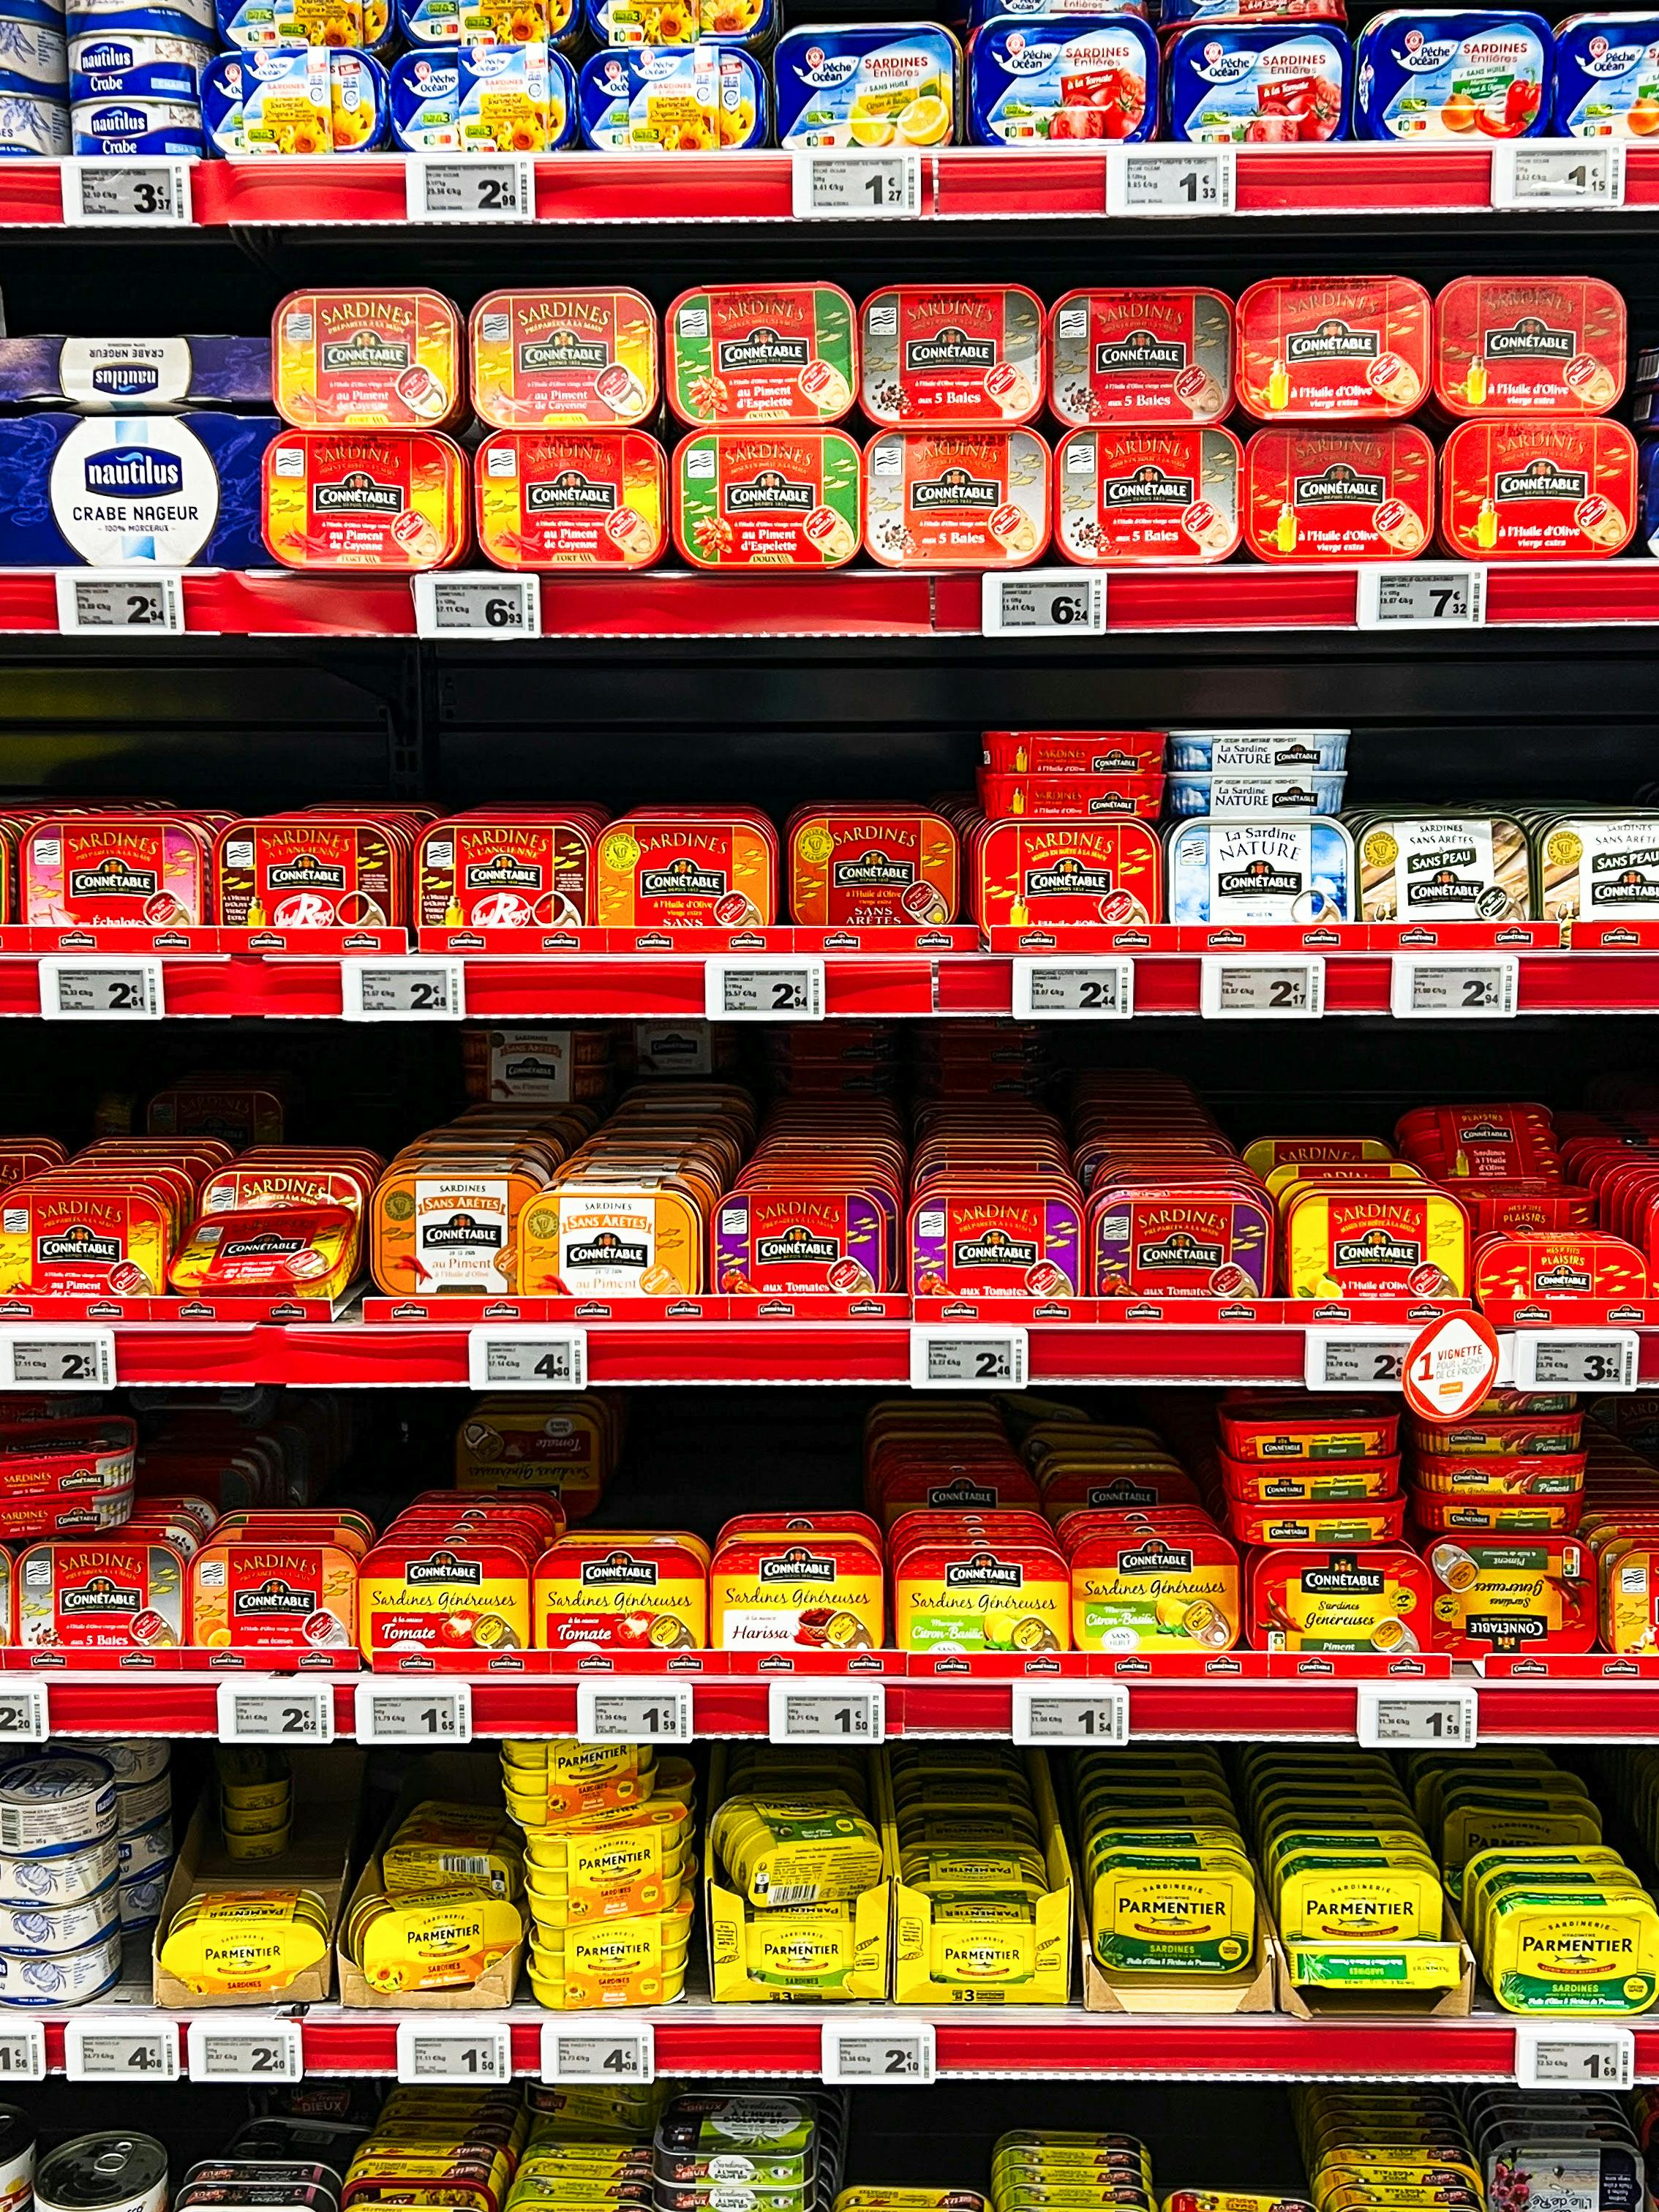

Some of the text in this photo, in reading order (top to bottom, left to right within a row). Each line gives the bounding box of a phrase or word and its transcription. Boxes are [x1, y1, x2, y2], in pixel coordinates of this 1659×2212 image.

[1023, 49, 1052, 60] Pêche
[1065, 47, 1129, 58] SARDINES
[1421, 46, 1449, 57] Pêche
[1464, 43, 1527, 54] SARDINES
[82, 47, 130, 69] nautilus
[865, 56, 928, 69] SARDINES
[1012, 60, 1042, 68] Océan
[1410, 56, 1439, 64] Océan
[823, 62, 851, 73] Pêche
[91, 76, 122, 91] Crabe
[430, 74, 456, 86] Pêche
[813, 73, 842, 81] Océan
[1075, 80, 1083, 89] la
[1086, 73, 1113, 87] Tomate
[421, 83, 448, 91] Océan
[478, 180, 501, 208] 2
[502, 195, 516, 206] 99
[865, 176, 882, 204] 1
[889, 190, 901, 200] 27
[1179, 173, 1196, 201] 1
[1203, 189, 1216, 198] 33
[134, 184, 157, 212] 3
[158, 199, 170, 210] 37
[320, 302, 412, 326] SARDINES
[1292, 334, 1371, 351] CONNÉTABLE
[90, 350, 164, 358] CRABE NAGEUR
[328, 346, 404, 361] CONNÉTABLE
[912, 342, 988, 359] CONNÉTABLE
[96, 372, 156, 390] nautilus
[936, 394, 943, 404] 5
[947, 392, 981, 405] Baies
[1291, 385, 1372, 398] à l'Huile d'Olive
[89, 457, 178, 484] nautilus
[533, 486, 609, 504] CONNÉTABLE
[732, 487, 808, 503] CONNÉTABLE
[73, 506, 198, 521] CRABE NAGEUR
[560, 530, 597, 542] Piment
[758, 530, 796, 541] Piment
[544, 541, 597, 552] de Cayenne
[741, 540, 797, 552] d'Espelette
[127, 595, 150, 622] 2
[151, 612, 163, 621] 94
[1051, 596, 1074, 625] 6
[1075, 611, 1087, 620] 24
[1429, 590, 1453, 617] 7
[1453, 604, 1466, 614] 32
[486, 599, 508, 626] 6
[509, 614, 522, 623] 93
[1220, 745, 1268, 754] La Sardine
[1217, 753, 1271, 764] NATURE
[1226, 829, 1296, 841] La Sardine
[1420, 824, 1463, 833] SARDINES
[69, 832, 159, 854] SARDINES
[461, 830, 549, 852] SARDINES
[640, 833, 727, 854] SARDINES
[833, 826, 917, 847] SARDINES
[1410, 832, 1473, 846] SANS ARÊTES
[477, 847, 538, 859] L'ANCIENNE
[1219, 840, 1301, 862] NATURE
[1412, 851, 1470, 870] SANS PEAU
[471, 868, 535, 882] CONNÉTABLE
[839, 865, 908, 879] CONNÉTABLE
[76, 874, 150, 889] CONNÉTABLE
[646, 873, 719, 889] CONNÉTABLE
[1223, 874, 1296, 888] CONNÉTABLE
[1409, 883, 1478, 899] CONNÉTABLE
[854, 907, 892, 916] SANS
[846, 914, 901, 925] ARÊTES
[109, 982, 131, 1009] 2
[132, 997, 143, 1007] 61
[772, 983, 794, 1009] 2
[794, 997, 808, 1007] 94
[1270, 980, 1292, 1006] 2
[1293, 995, 1306, 1004] 17
[425, 1196, 500, 1208] SANS ARÊTES
[37, 1200, 123, 1223] SARDINES
[756, 1202, 840, 1222] SARDINES
[1334, 1204, 1422, 1226] SARDINES
[426, 1227, 496, 1241] CONNÉTABLE
[43, 1240, 114, 1256] CONNÉTABLE
[761, 1241, 833, 1256] CONNÉTABLE
[1339, 1246, 1414, 1261] CONNÉTABLE
[432, 1259, 491, 1268] au Piment
[1541, 1257, 1585, 1266] PLAISIRS
[763, 1282, 830, 1293] aux Tomates
[1538, 1274, 1587, 1286] CONNÉTABLE
[1437, 1345, 1483, 1361] VIGNETTE
[976, 1353, 998, 1377] 2
[997, 1366, 1009, 1375] 40
[1418, 1352, 1434, 1381] 1
[1437, 1360, 1455, 1369] POUR
[1445, 1369, 1455, 1377] CE
[1456, 1364, 1486, 1377] PRODUIT
[1584, 1355, 1605, 1380] 3
[1606, 1368, 1619, 1377] 92
[59, 1553, 142, 1573] SARDINES
[410, 1564, 476, 1579] CONNÉTABLE
[65, 1592, 135, 1606] CONNÉTABLE
[372, 1590, 516, 1610] Sardines Généreuses
[1319, 1601, 1359, 1611] Sardines
[382, 1624, 435, 1640] Tomate
[732, 1625, 790, 1639] Harissa
[911, 1625, 983, 1640] Citron-Basilic
[1323, 1642, 1355, 1651] Piment
[282, 1709, 303, 1732] 2
[304, 1721, 316, 1730] 62
[421, 1709, 437, 1732] 1
[442, 1722, 454, 1730] 65
[835, 1709, 850, 1733] 1
[856, 1721, 867, 1730] 50
[579, 1849, 651, 1871] PARMENTIER
[1143, 1883, 1205, 1895] SARDINERIE
[1118, 1899, 1225, 1916] PARMENTIER
[764, 1944, 838, 1956] PARMENTIER
[1522, 1936, 1632, 1954] PARMENTIER
[206, 1946, 281, 1960] PARMENTIER
[128, 2047, 148, 2069] 4
[150, 2059, 162, 2067] 08
[1583, 2054, 1598, 2078] 1
[1603, 2067, 1616, 2077] 69
